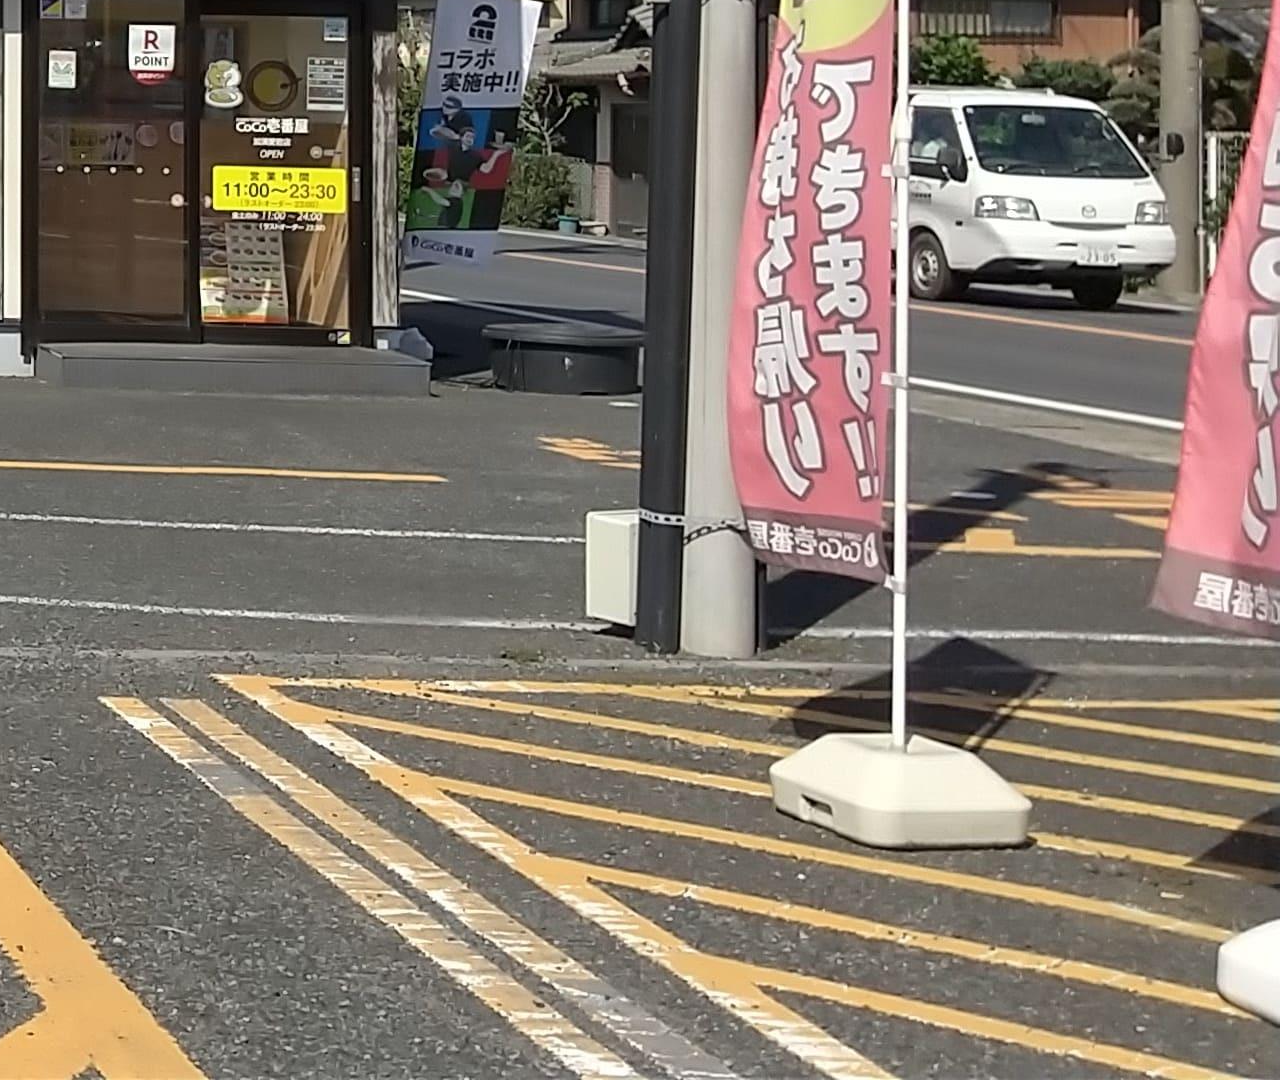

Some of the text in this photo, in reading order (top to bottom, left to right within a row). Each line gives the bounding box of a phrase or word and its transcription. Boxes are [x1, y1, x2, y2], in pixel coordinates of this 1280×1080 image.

[144, 30, 159, 50] R
[134, 55, 169, 66] POINT
[437, 48, 497, 69] コラボ
[260, 149, 284, 159] OPEN
